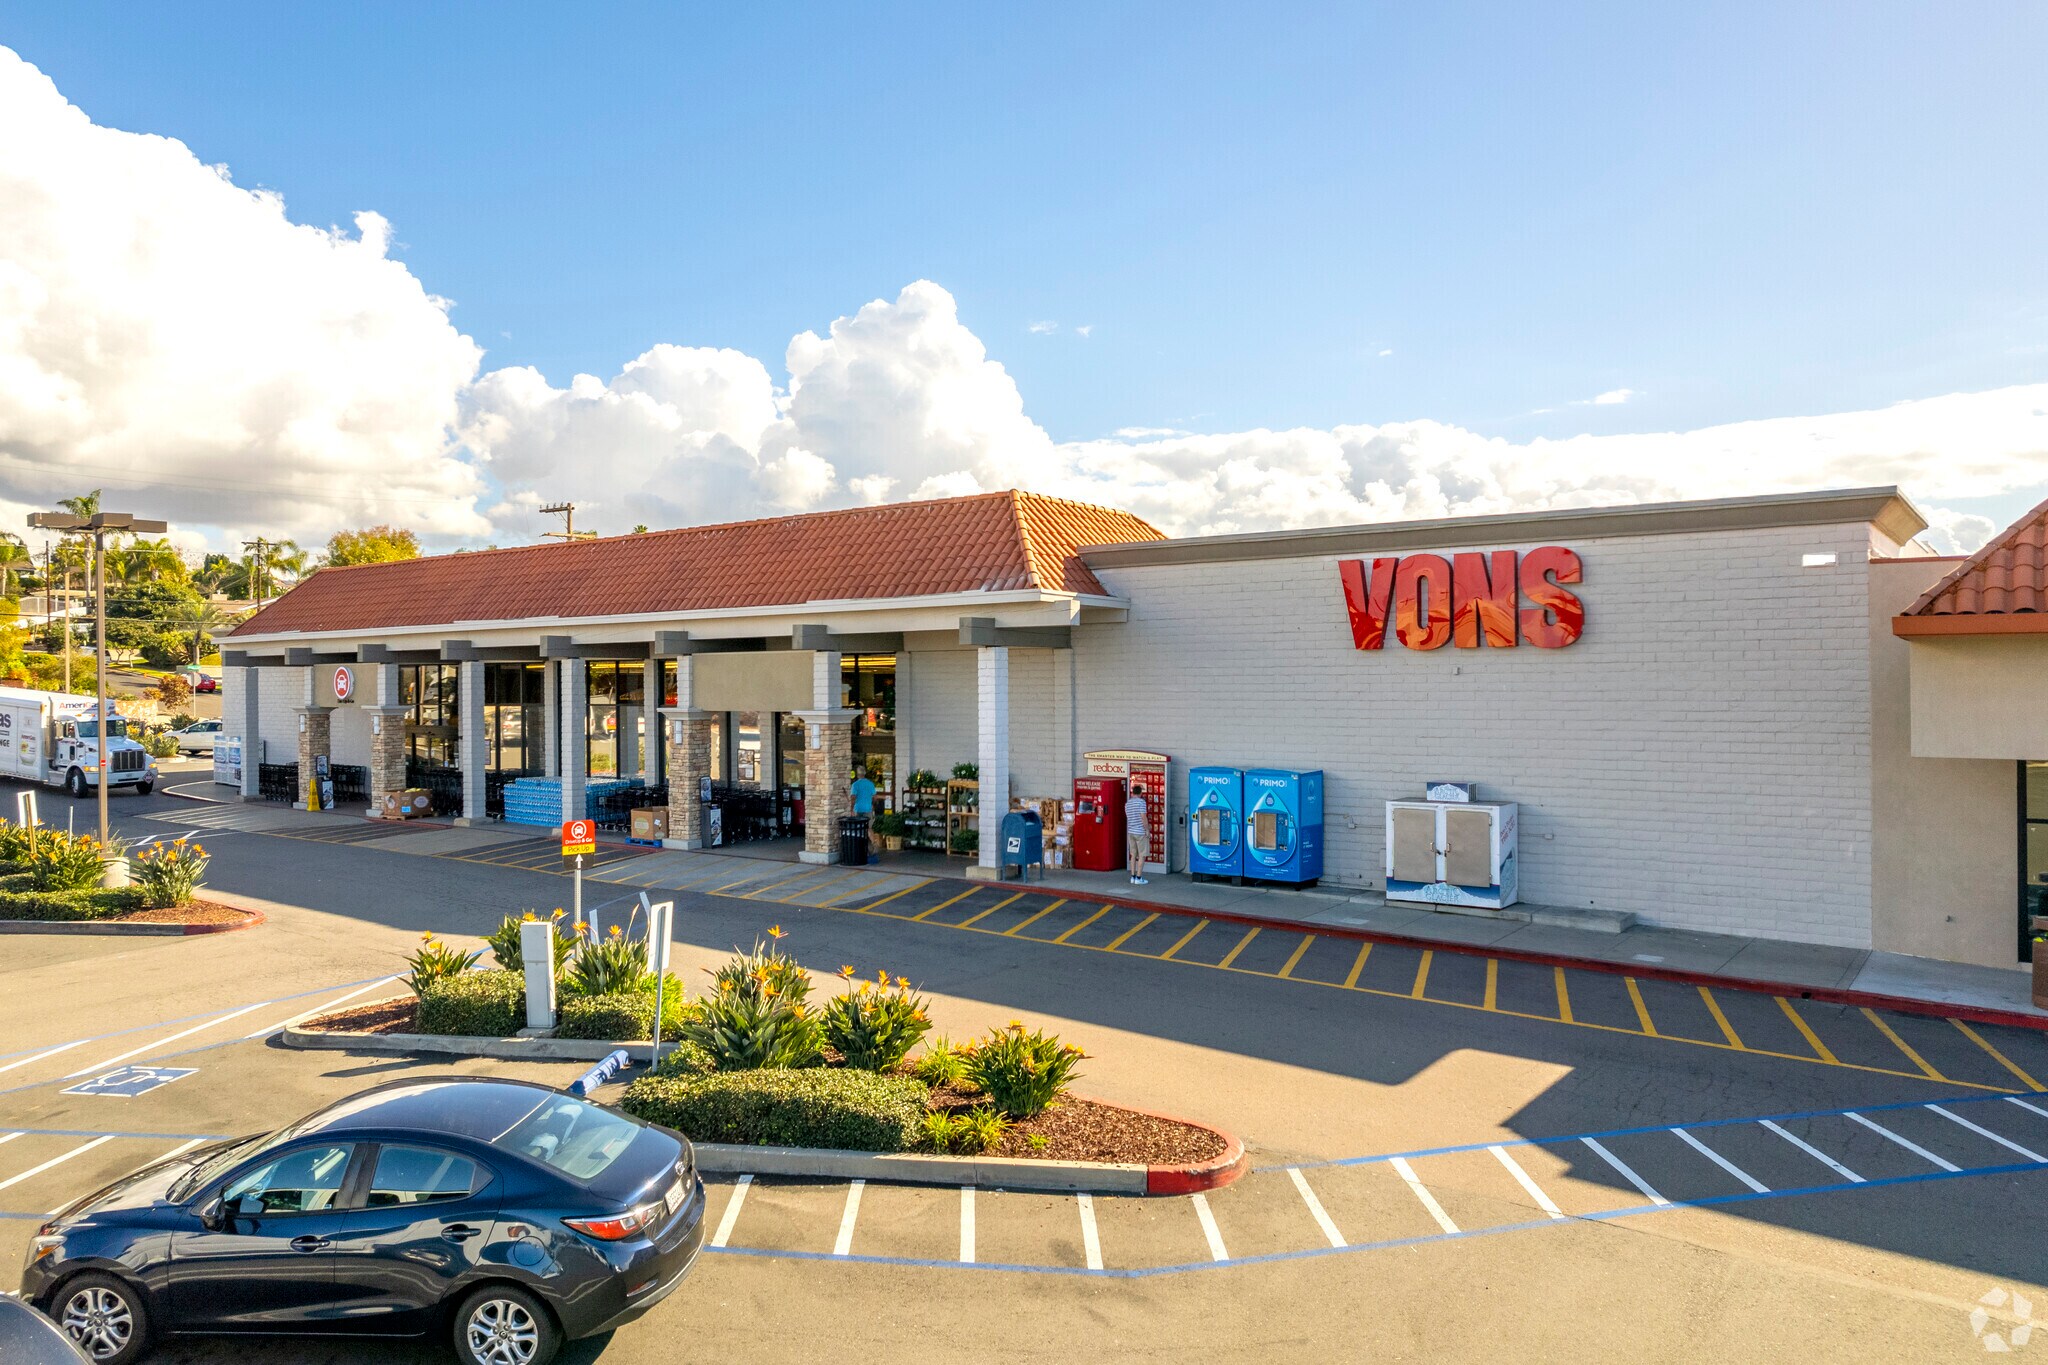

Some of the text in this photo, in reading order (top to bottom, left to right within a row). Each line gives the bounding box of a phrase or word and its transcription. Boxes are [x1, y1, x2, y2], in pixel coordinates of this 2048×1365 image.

[1338, 546, 1584, 650] VONS
[1204, 777, 1228, 785] PRIMO
[1260, 778, 1285, 788] PRIMO
